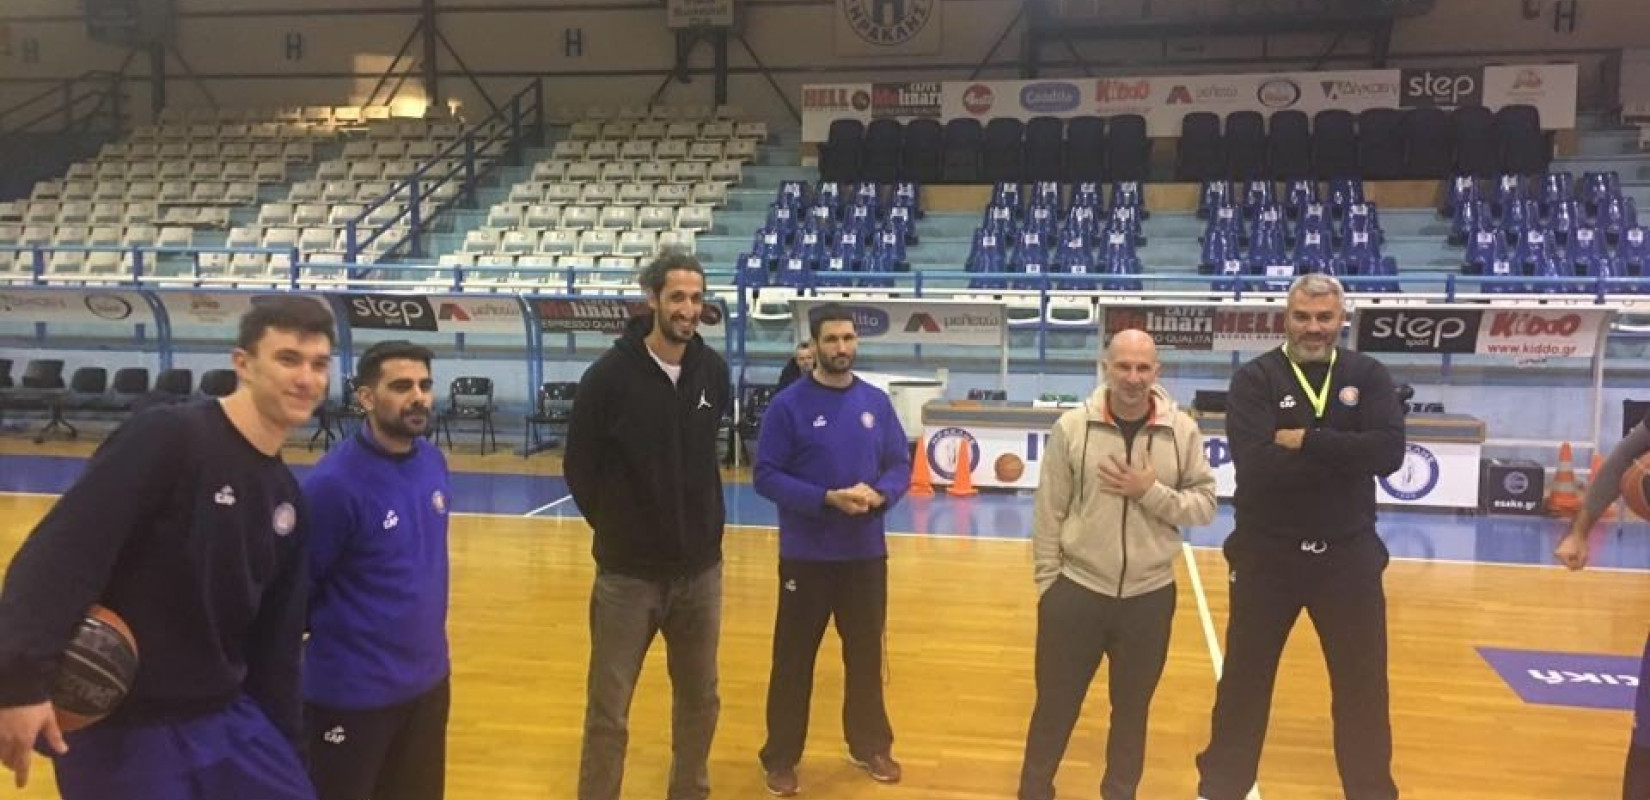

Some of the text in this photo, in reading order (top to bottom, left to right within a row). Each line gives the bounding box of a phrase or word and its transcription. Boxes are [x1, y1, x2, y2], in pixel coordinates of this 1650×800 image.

[1408, 72, 1474, 103] step
[352, 295, 424, 327] step
[1372, 313, 1466, 349] step
[1487, 342, 1577, 357] www.kiddo.gr
